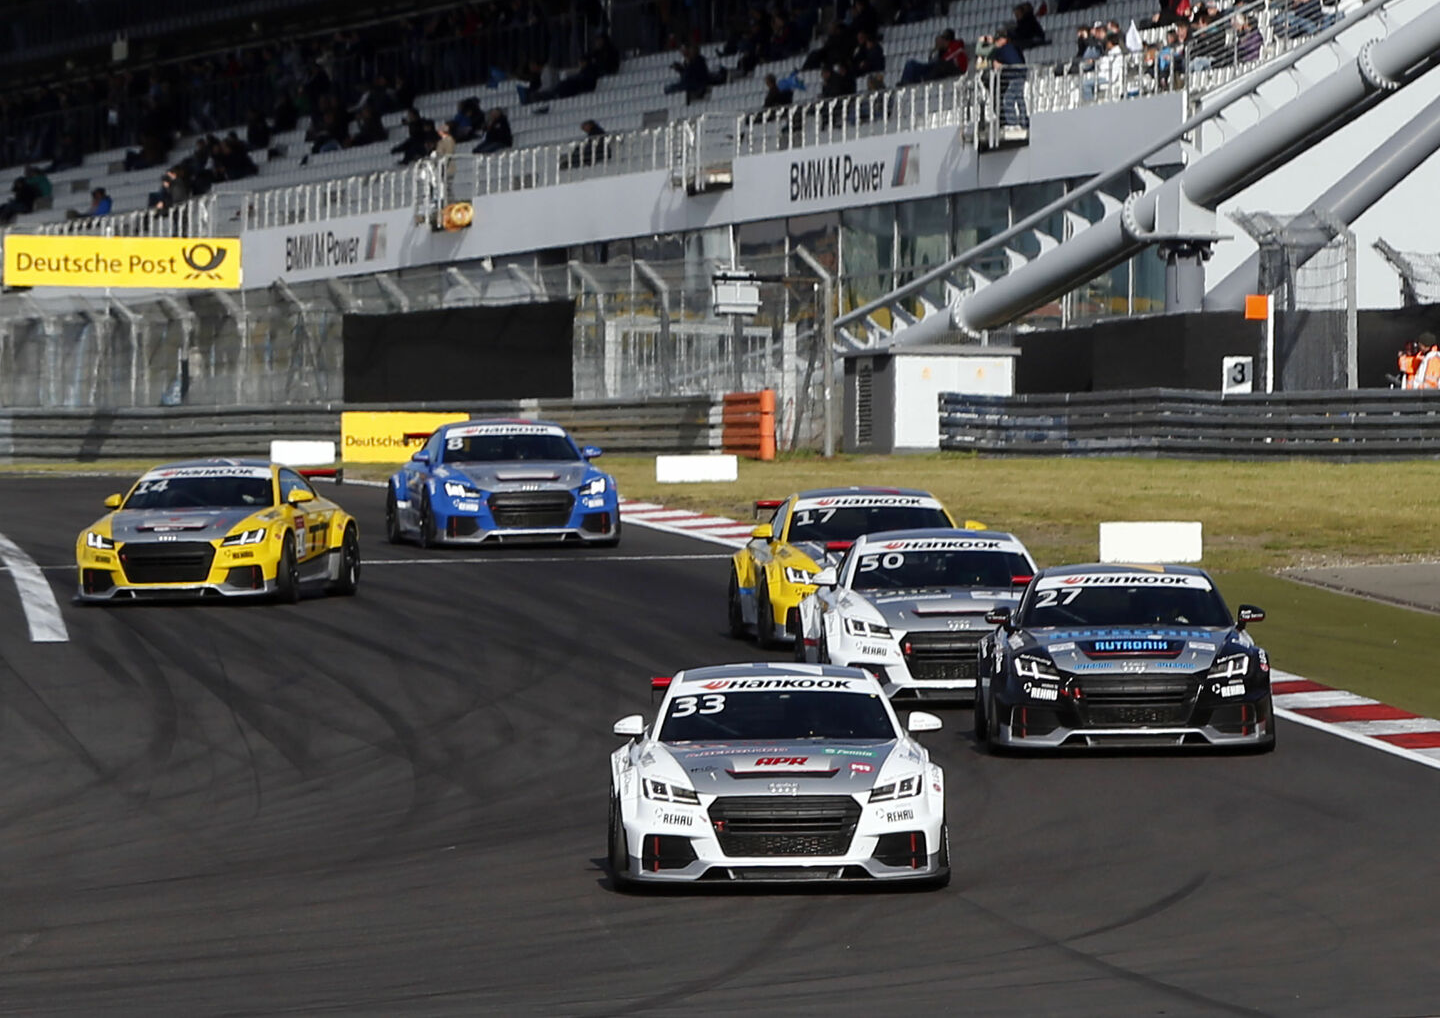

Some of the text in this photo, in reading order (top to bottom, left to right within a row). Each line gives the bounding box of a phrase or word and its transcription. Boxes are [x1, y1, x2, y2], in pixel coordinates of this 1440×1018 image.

[790, 154, 885, 202] BMW M Power
[286, 231, 359, 272] BMW M Power
[16, 252, 177, 274] Deutsche Post
[1232, 362, 1245, 384] 3
[345, 435, 403, 448] Deutsche
[447, 437, 464, 451] 8
[134, 479, 171, 496] 14
[834, 497, 922, 506] HANKOOK
[796, 508, 838, 527] 17
[903, 540, 1002, 550] HANKOOK
[860, 552, 905, 573] 50
[1082, 575, 1190, 586] HANKOOK
[1035, 587, 1084, 609] 27
[1095, 640, 1169, 651] RUTRONIK
[728, 678, 852, 690] HANKOOK
[1030, 687, 1058, 701] REHAU
[672, 694, 726, 718] 33
[755, 757, 809, 766] APR
[663, 813, 693, 826] REHAU
[887, 809, 914, 822] REHAU
